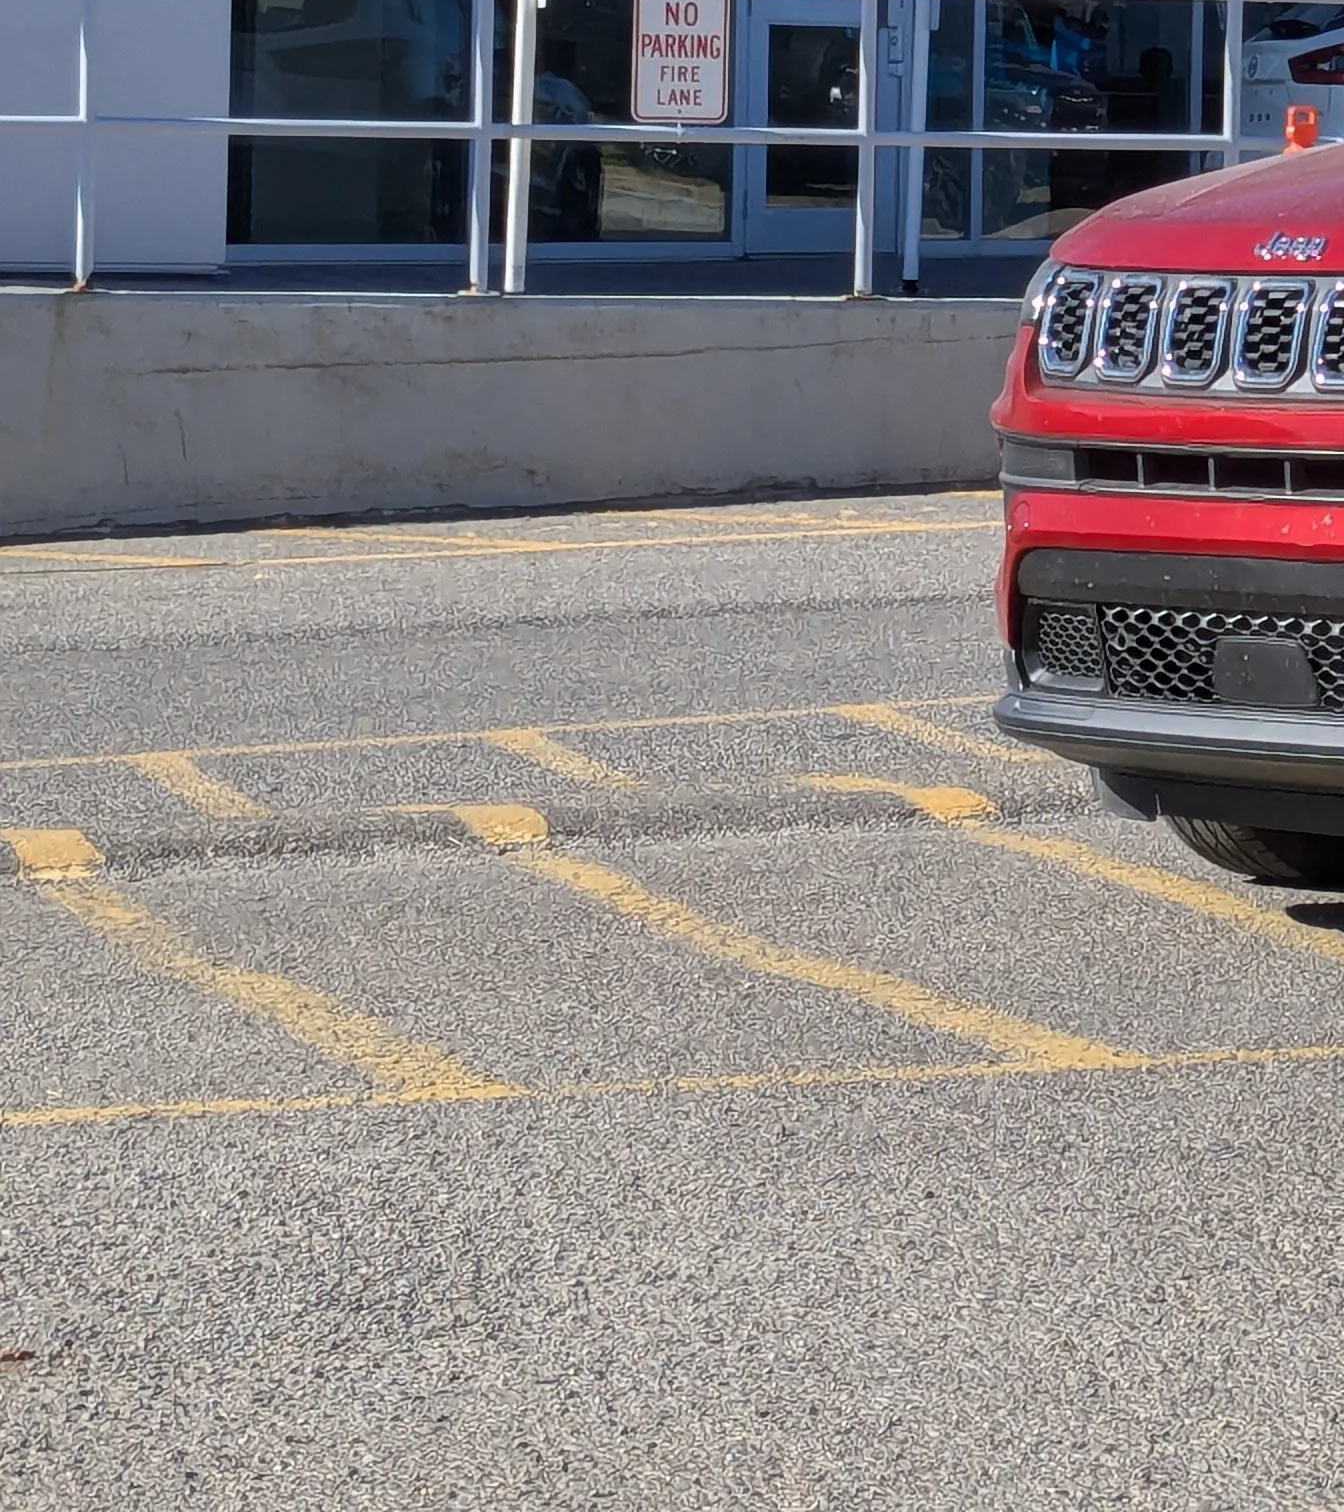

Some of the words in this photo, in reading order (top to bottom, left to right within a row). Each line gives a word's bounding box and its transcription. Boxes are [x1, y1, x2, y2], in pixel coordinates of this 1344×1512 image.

[665, 1, 698, 27] NO
[641, 34, 721, 60] PARKING
[660, 65, 701, 83] FIRE
[656, 89, 702, 106] LANE
[1253, 231, 1328, 261] Jeep
